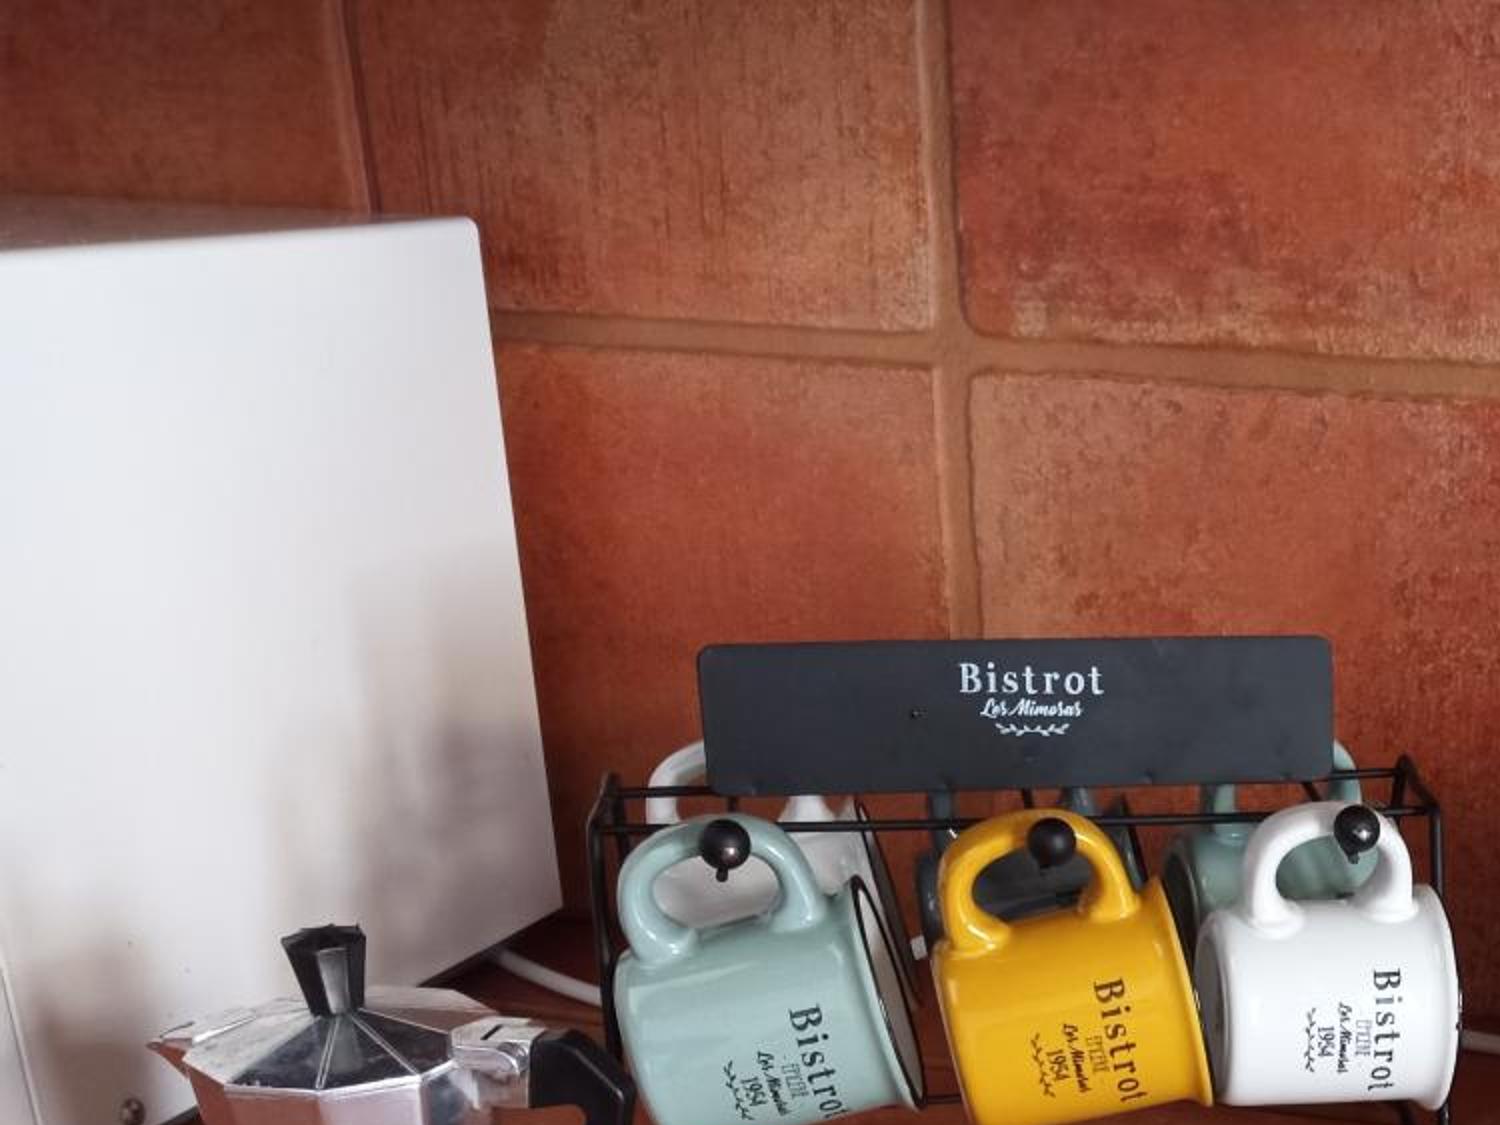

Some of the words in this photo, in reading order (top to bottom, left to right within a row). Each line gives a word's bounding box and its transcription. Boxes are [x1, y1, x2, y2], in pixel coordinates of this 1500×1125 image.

[959, 661, 1105, 695] Bistrot
[1008, 698, 1083, 718] Mimosas
[1093, 977, 1148, 1103] Bistrot
[1367, 967, 1403, 1091] Bistrot
